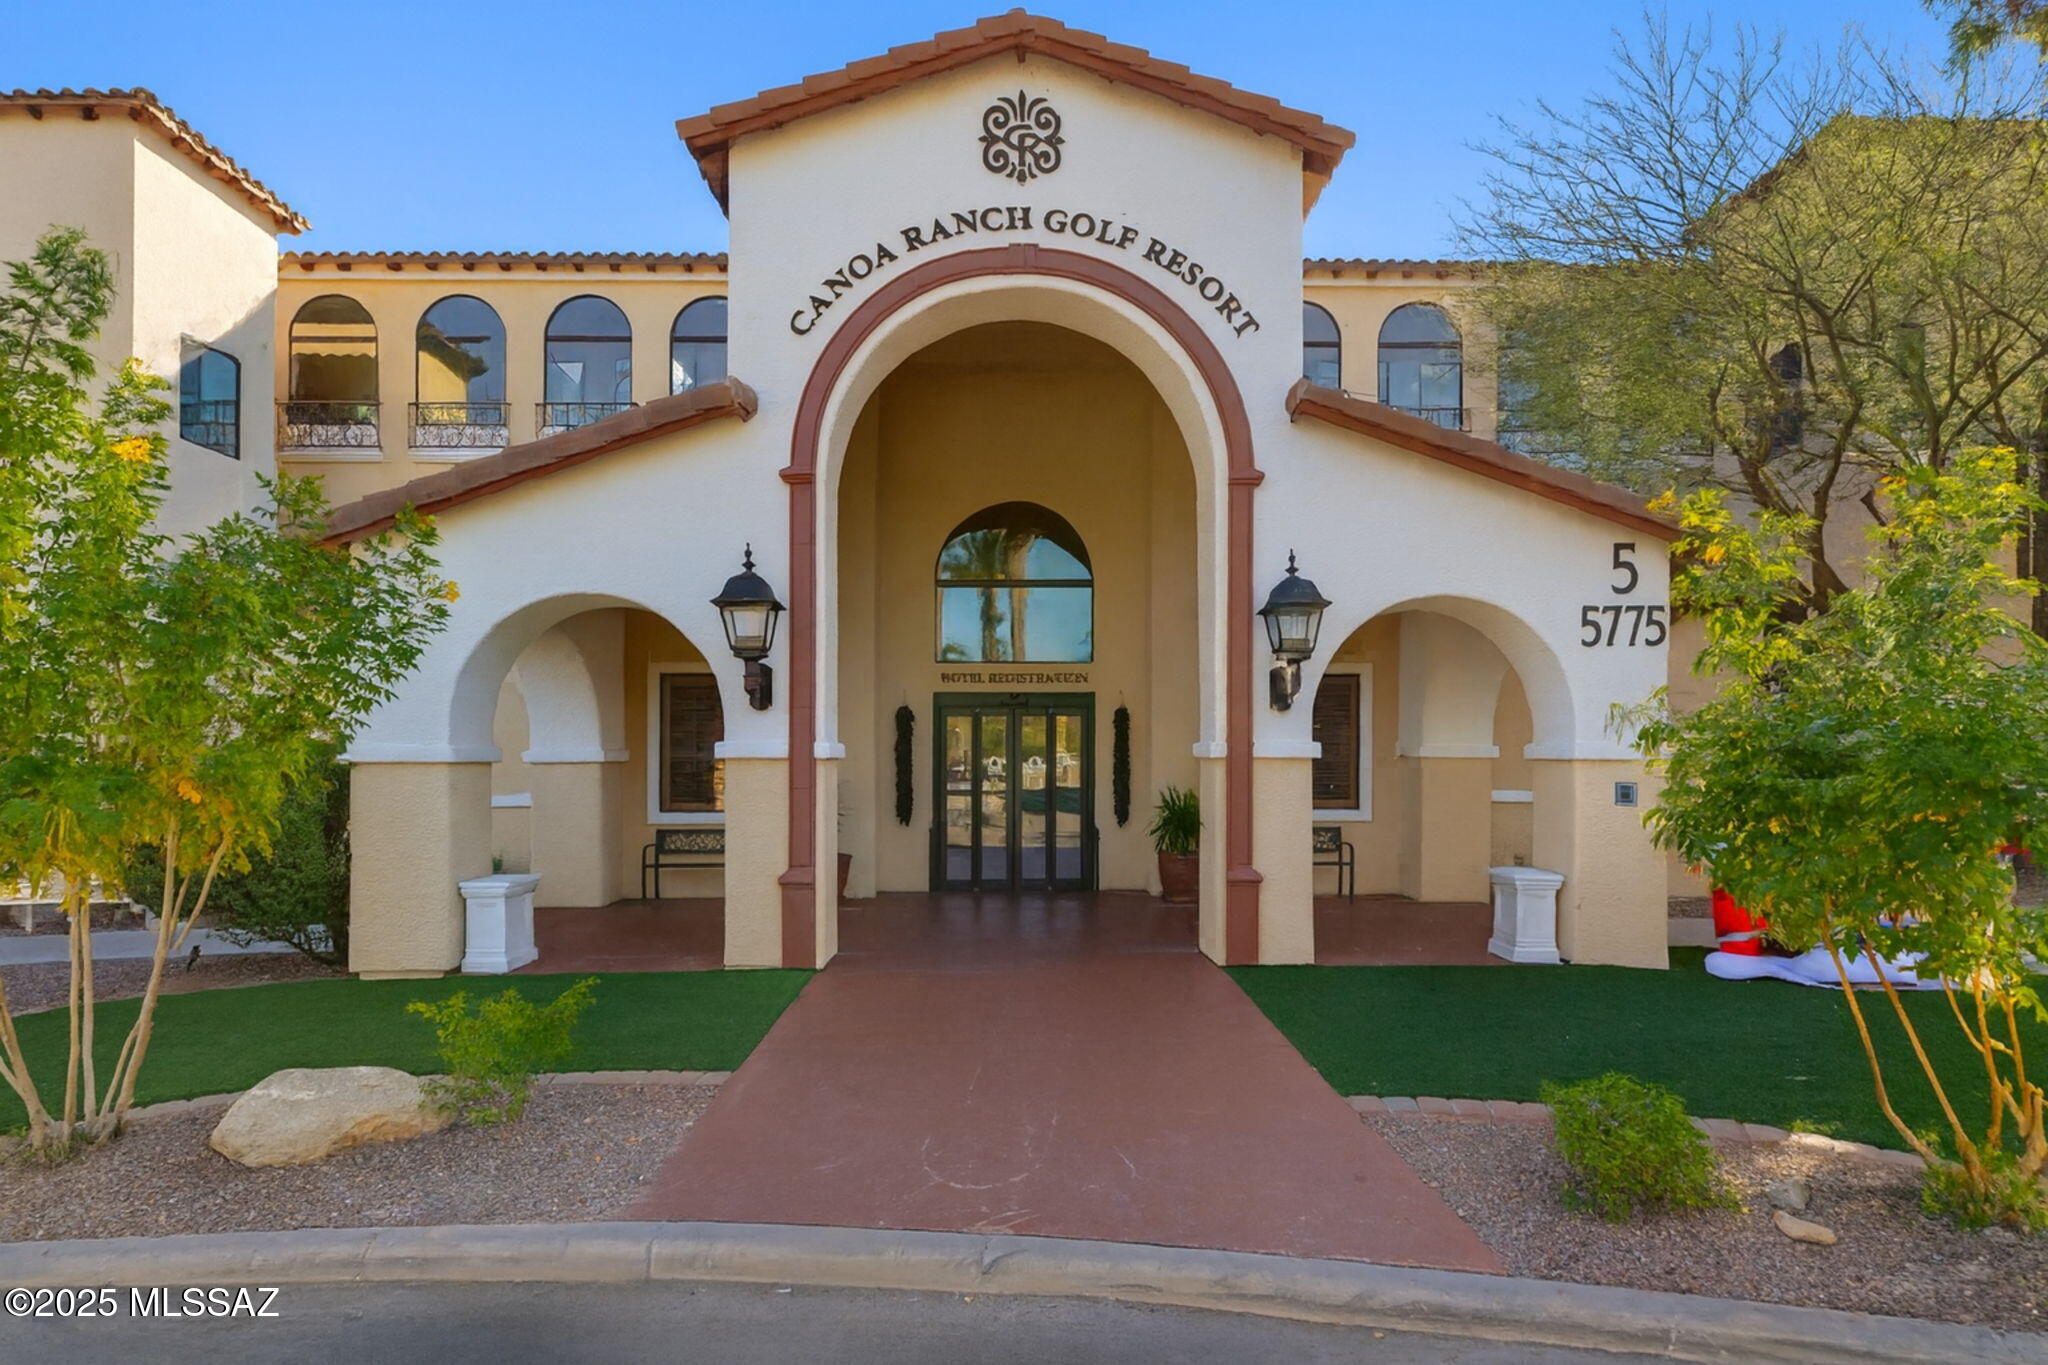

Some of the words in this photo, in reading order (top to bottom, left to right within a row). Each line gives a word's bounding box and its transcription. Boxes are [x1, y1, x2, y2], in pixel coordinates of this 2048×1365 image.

[789, 242, 898, 337] CANOA
[900, 206, 1031, 252] RANCH
[1043, 209, 1139, 250] GOLF
[1142, 237, 1261, 339] RESORT
[1611, 542, 1639, 595] 5
[1581, 605, 1667, 647] 5775
[941, 672, 986, 684] HOTEL
